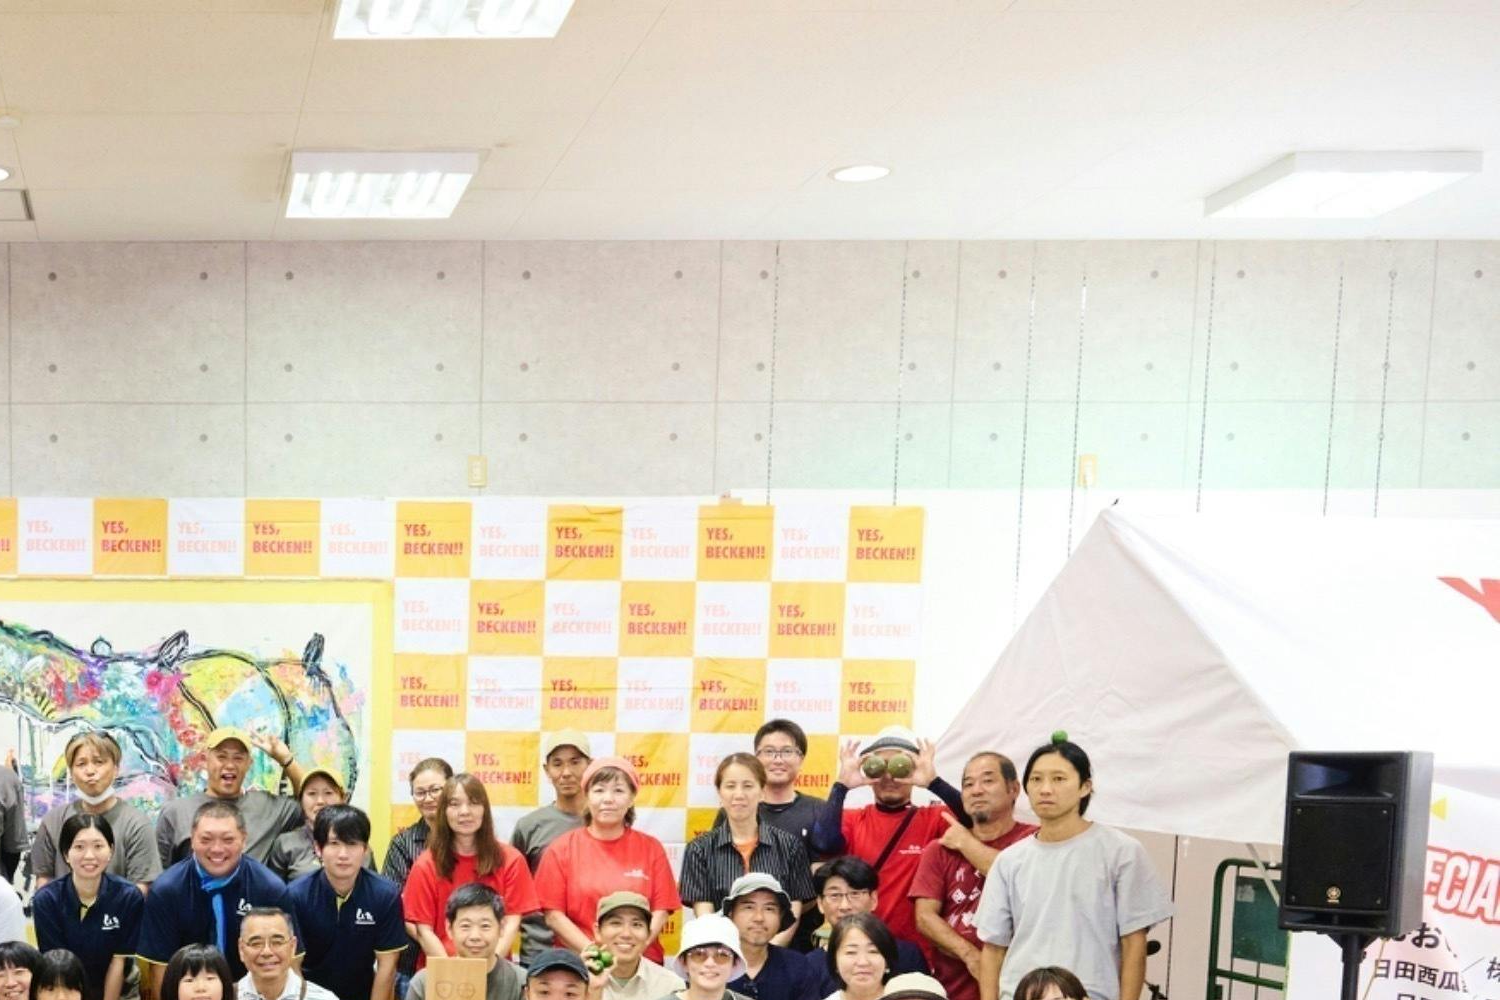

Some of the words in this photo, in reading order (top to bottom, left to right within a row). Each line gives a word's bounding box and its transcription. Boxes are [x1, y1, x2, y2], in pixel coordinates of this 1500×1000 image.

[102, 522, 128, 536] YES,
[253, 523, 279, 537] YES,
[404, 524, 430, 538] YES,
[555, 526, 580, 540] YES,
[707, 528, 731, 541] YES,
[858, 528, 883, 542] YES,
[100, 538, 161, 553] BECKEN!!
[252, 540, 312, 554] BECKEN!!
[404, 542, 463, 555] BECKEN!!
[553, 543, 612, 557] BECKEN!!
[704, 544, 763, 558] BECKEN!!
[855, 546, 912, 560] BECKEN!!
[477, 602, 504, 616] YES,
[628, 603, 654, 617] YES,
[778, 604, 803, 618] YES,
[476, 620, 536, 633] BECKEN!!
[628, 621, 687, 635] BECKEN!!
[777, 622, 833, 636] BECKEN!!
[401, 676, 426, 691] YES,
[551, 679, 578, 692] YES,
[699, 679, 724, 693] YES,
[848, 681, 874, 695] YES,
[400, 694, 460, 707] BECKEN!!
[548, 696, 606, 710] BECKEN!!
[699, 698, 756, 712] BECKEN!!
[847, 699, 906, 713] BECKEN!!
[474, 754, 499, 766] YES,
[1374, 959, 1467, 993] 日田西瓜
